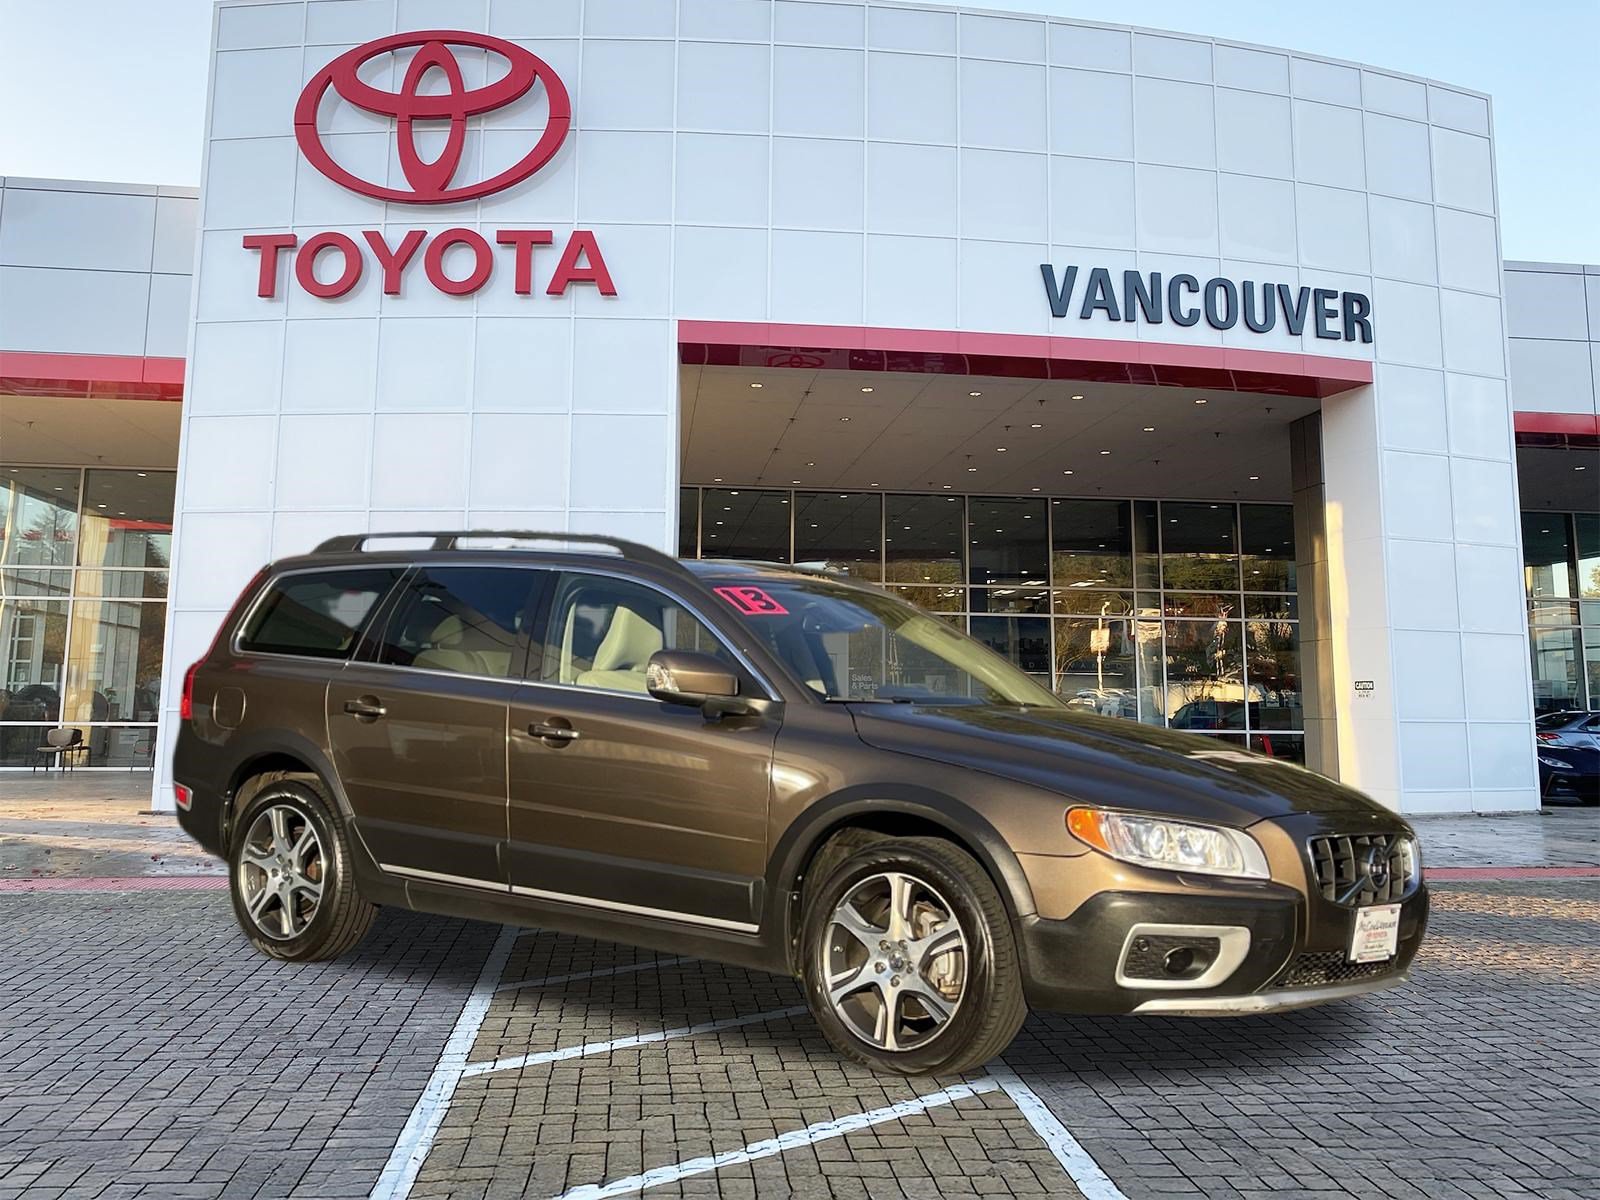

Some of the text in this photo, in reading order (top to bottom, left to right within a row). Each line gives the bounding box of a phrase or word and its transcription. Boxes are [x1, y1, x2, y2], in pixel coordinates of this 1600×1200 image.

[243, 228, 618, 299] TOYOTA
[1040, 264, 1373, 343] VANCOUVER
[720, 589, 776, 611] 13
